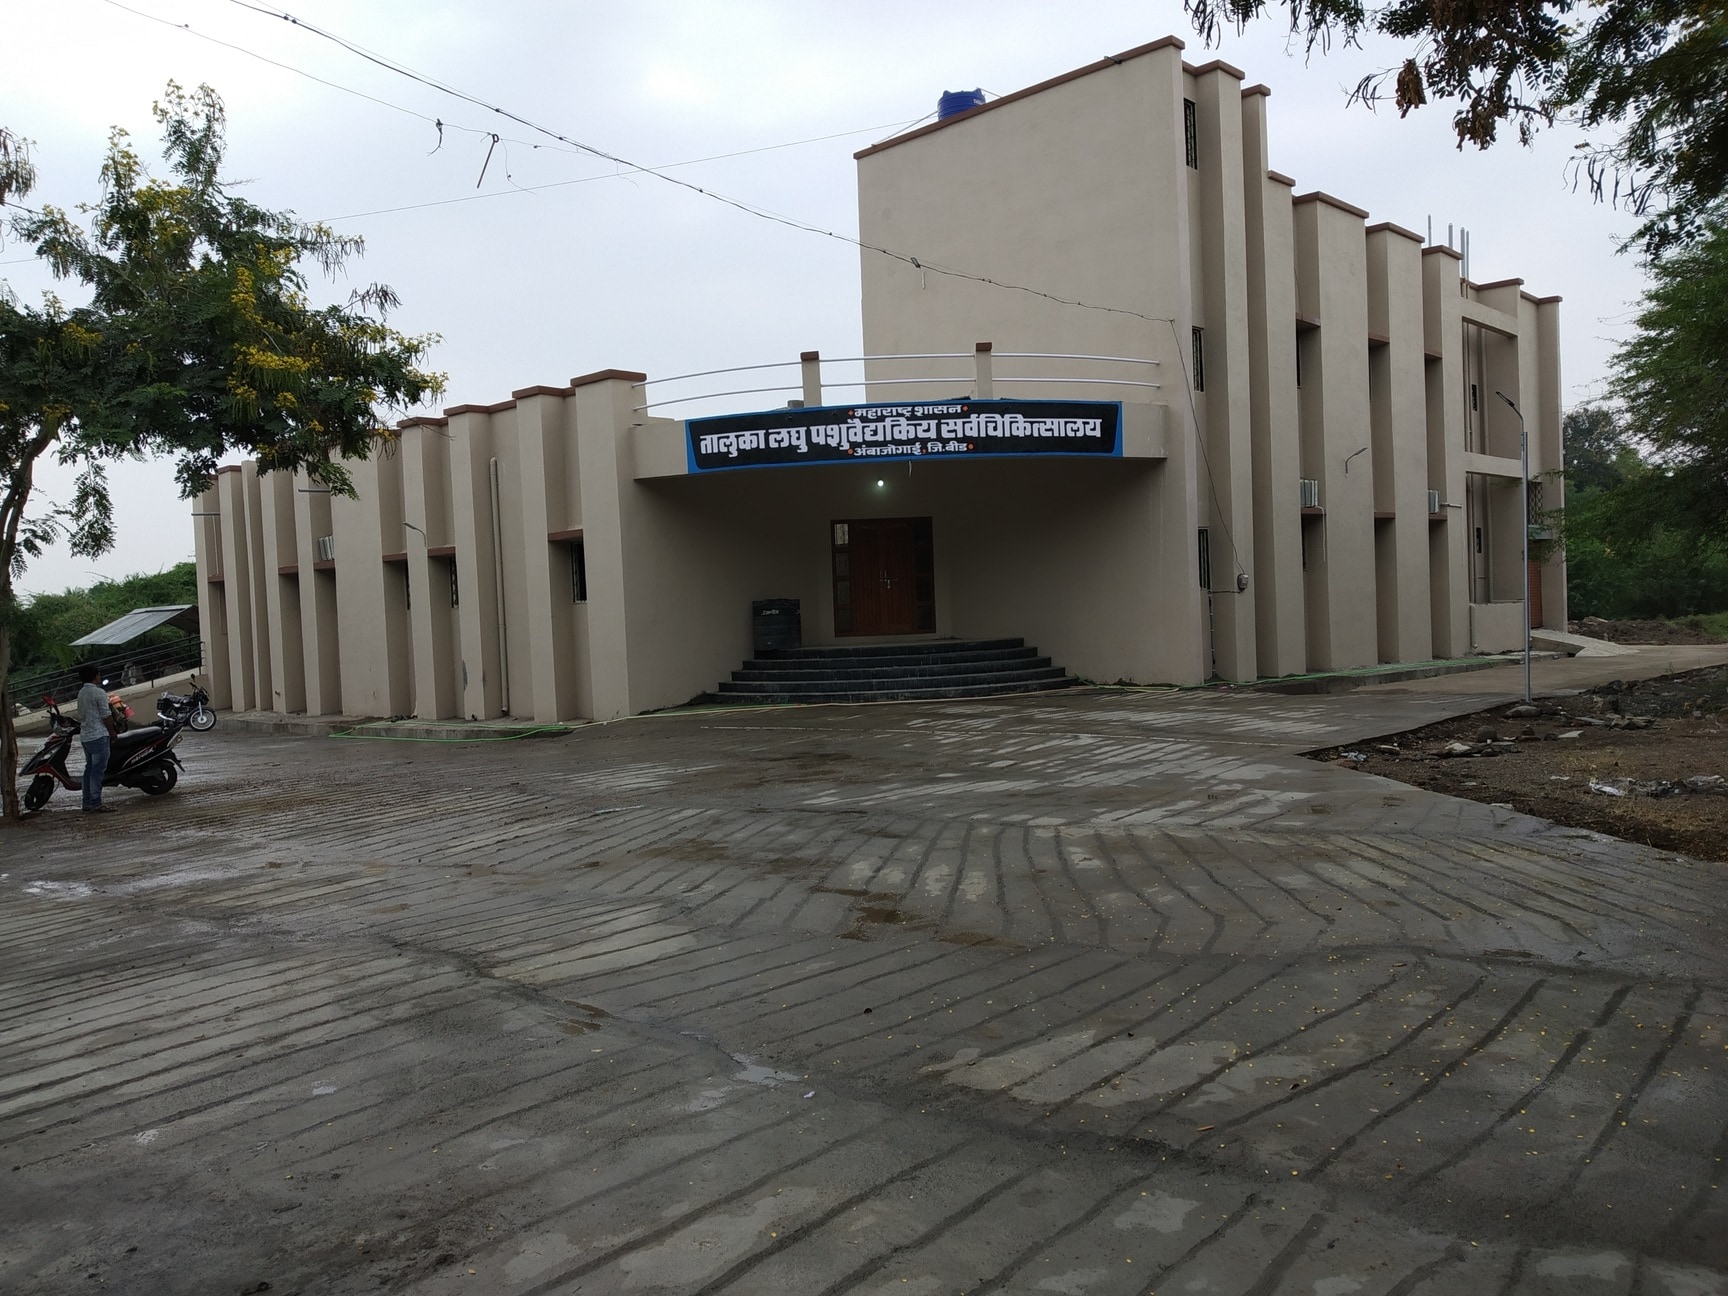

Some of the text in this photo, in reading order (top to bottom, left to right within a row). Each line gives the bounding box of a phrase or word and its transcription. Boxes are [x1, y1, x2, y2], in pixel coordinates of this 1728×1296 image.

[854, 404, 962, 420] महाराष्ट्र शासन
[700, 413, 1102, 457] तालुका लघु पशुवैद्यकिय सर्वचिकित्सालय
